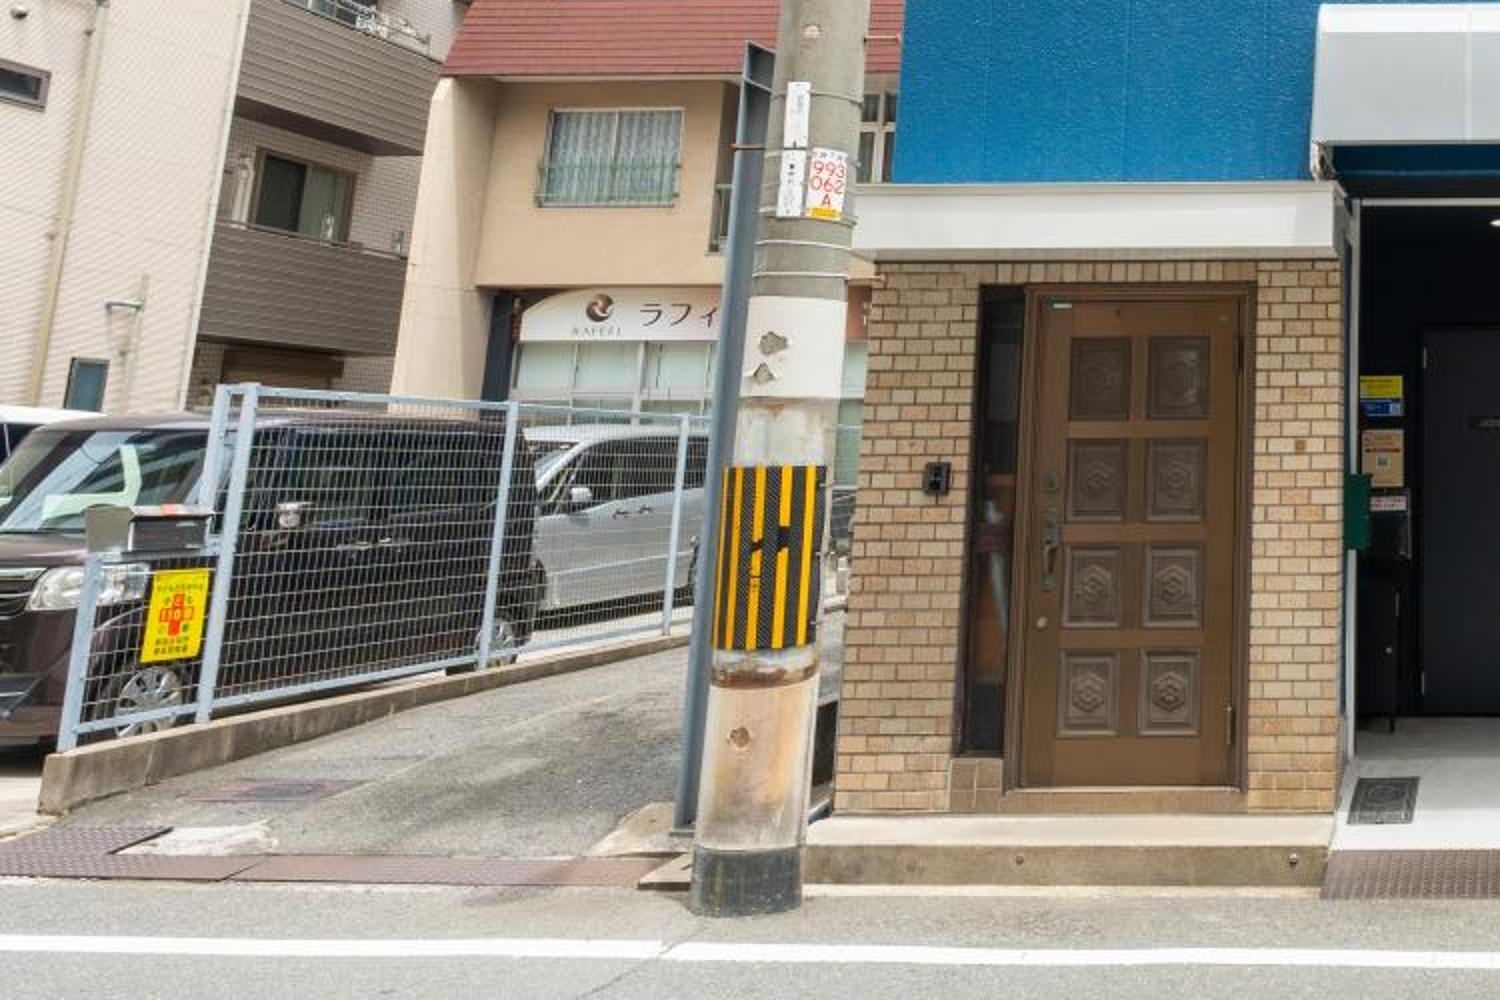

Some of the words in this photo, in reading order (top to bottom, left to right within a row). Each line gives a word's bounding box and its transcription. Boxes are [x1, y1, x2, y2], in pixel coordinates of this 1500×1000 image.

[813, 160, 846, 179] 993
[809, 175, 844, 194] 062
[821, 193, 831, 207] A
